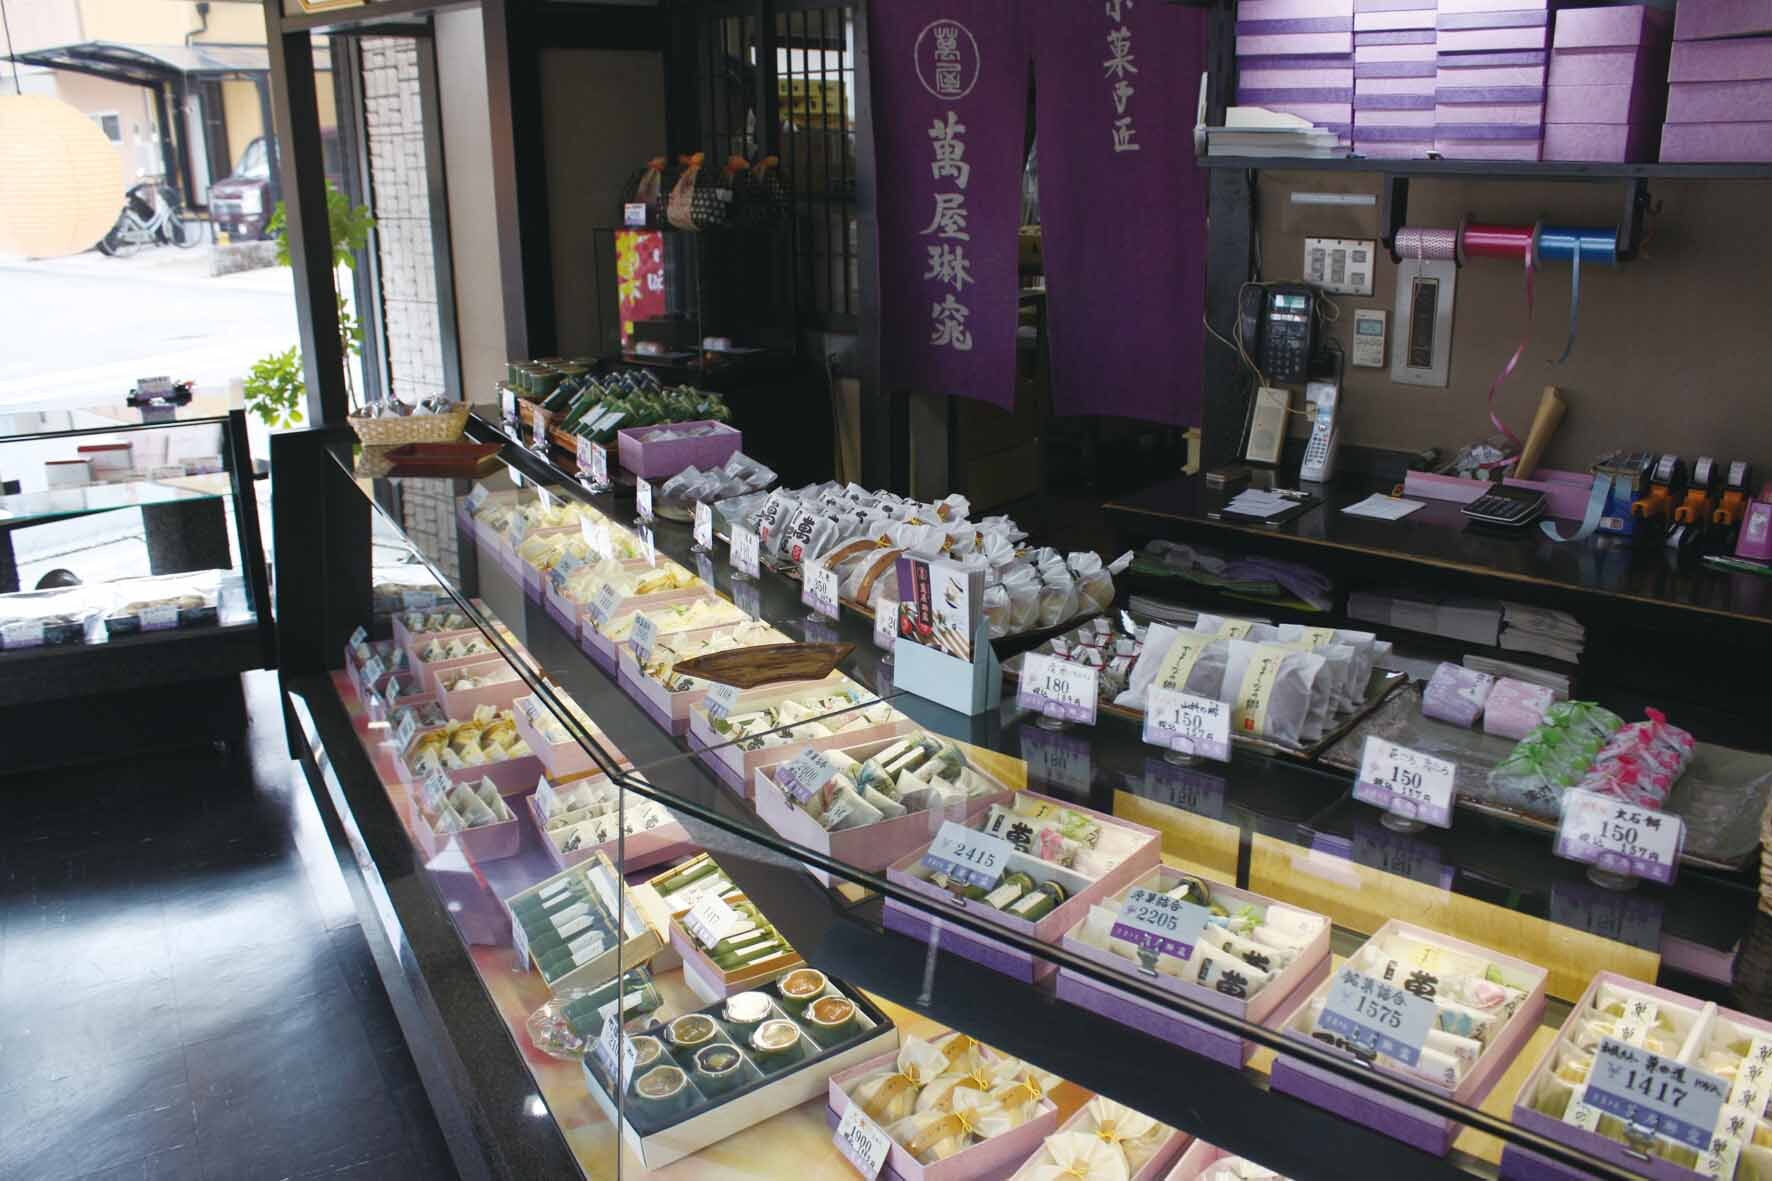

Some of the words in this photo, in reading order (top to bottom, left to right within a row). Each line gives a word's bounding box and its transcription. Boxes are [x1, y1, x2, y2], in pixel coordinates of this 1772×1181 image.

[1046, 676, 1069, 693] 180
[1175, 709, 1202, 728] 150
[1392, 766, 1422, 788] 150
[1600, 821, 1638, 844] 150
[953, 842, 996, 868] 2415
[1137, 906, 1179, 931] 2205
[1355, 996, 1403, 1029] 1575
[1625, 1069, 1688, 1108] 1417
[851, 1126, 872, 1152] 1900
